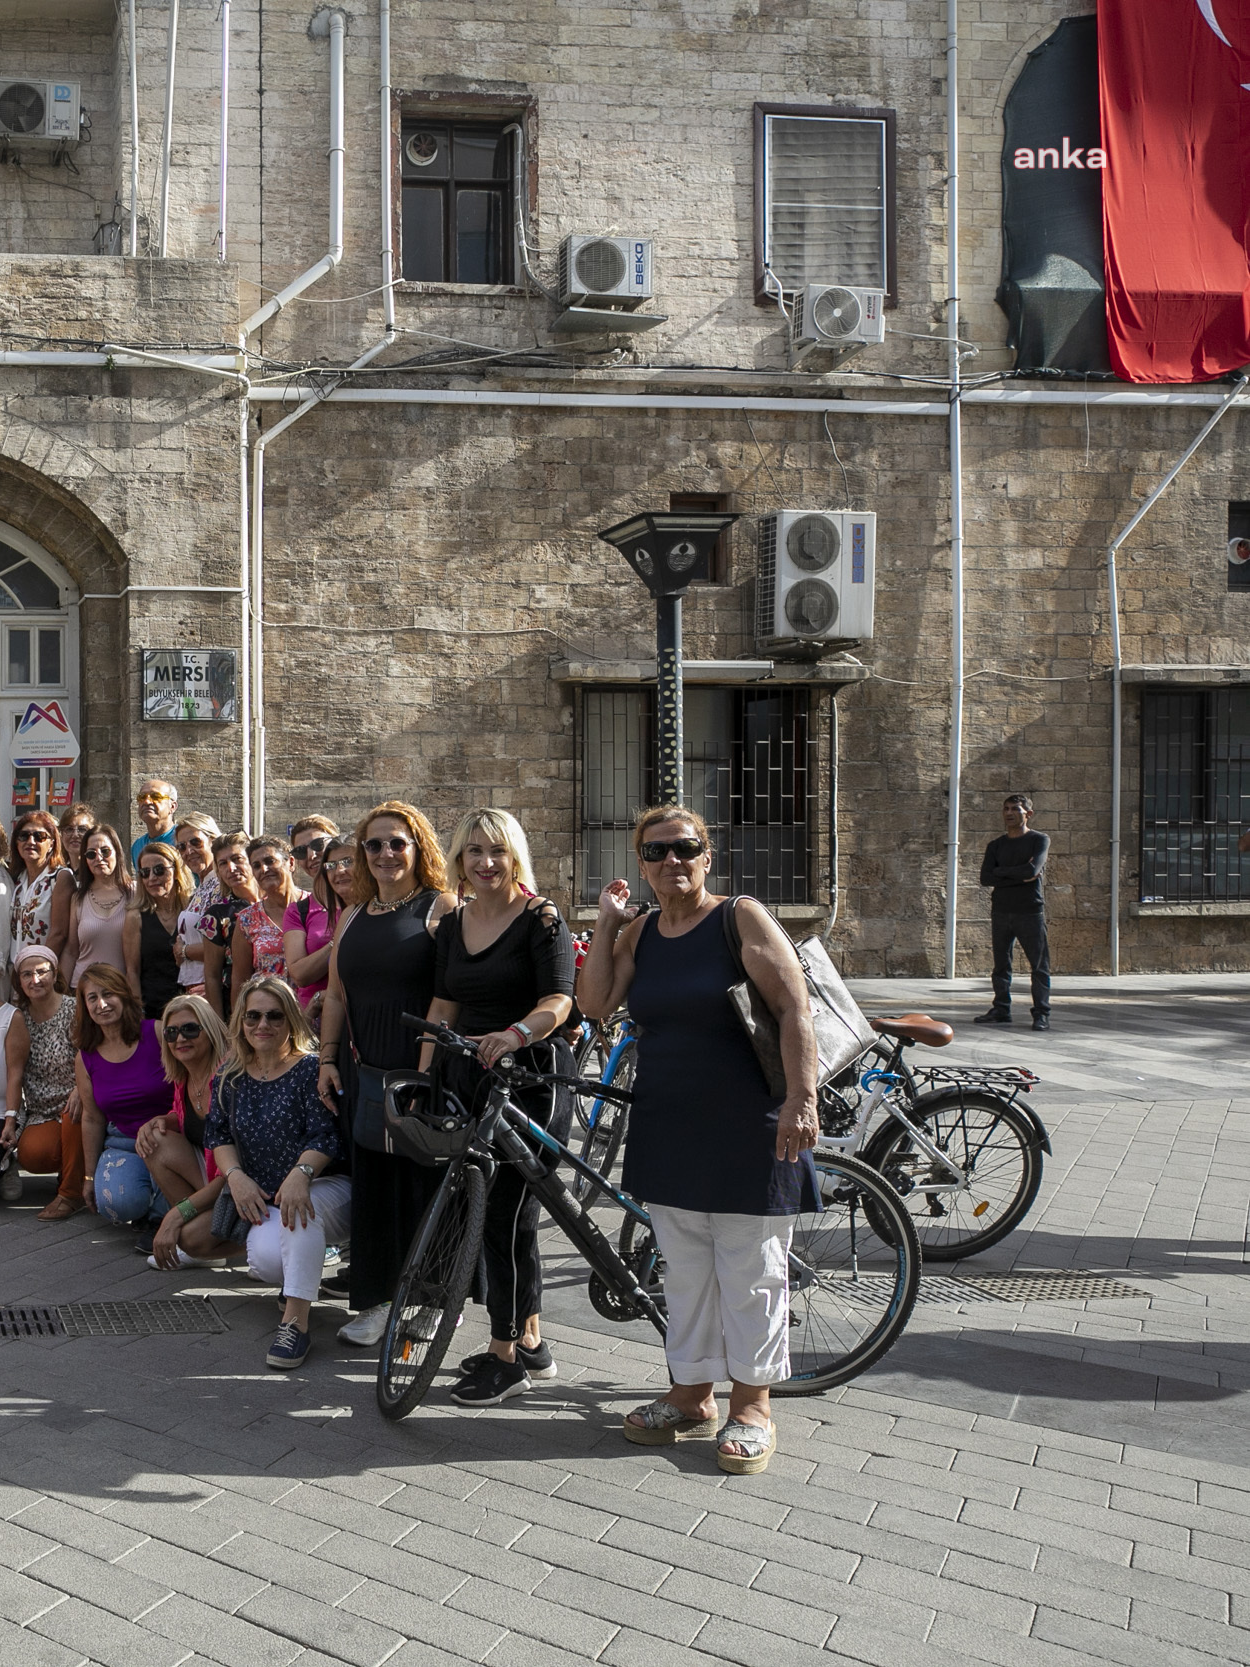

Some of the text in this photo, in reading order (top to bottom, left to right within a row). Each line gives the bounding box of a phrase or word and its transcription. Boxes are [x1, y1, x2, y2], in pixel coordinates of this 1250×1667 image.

[635, 242, 644, 285] BEKO
[184, 655, 200, 664] T.C.
[181, 702, 200, 710] 1873
